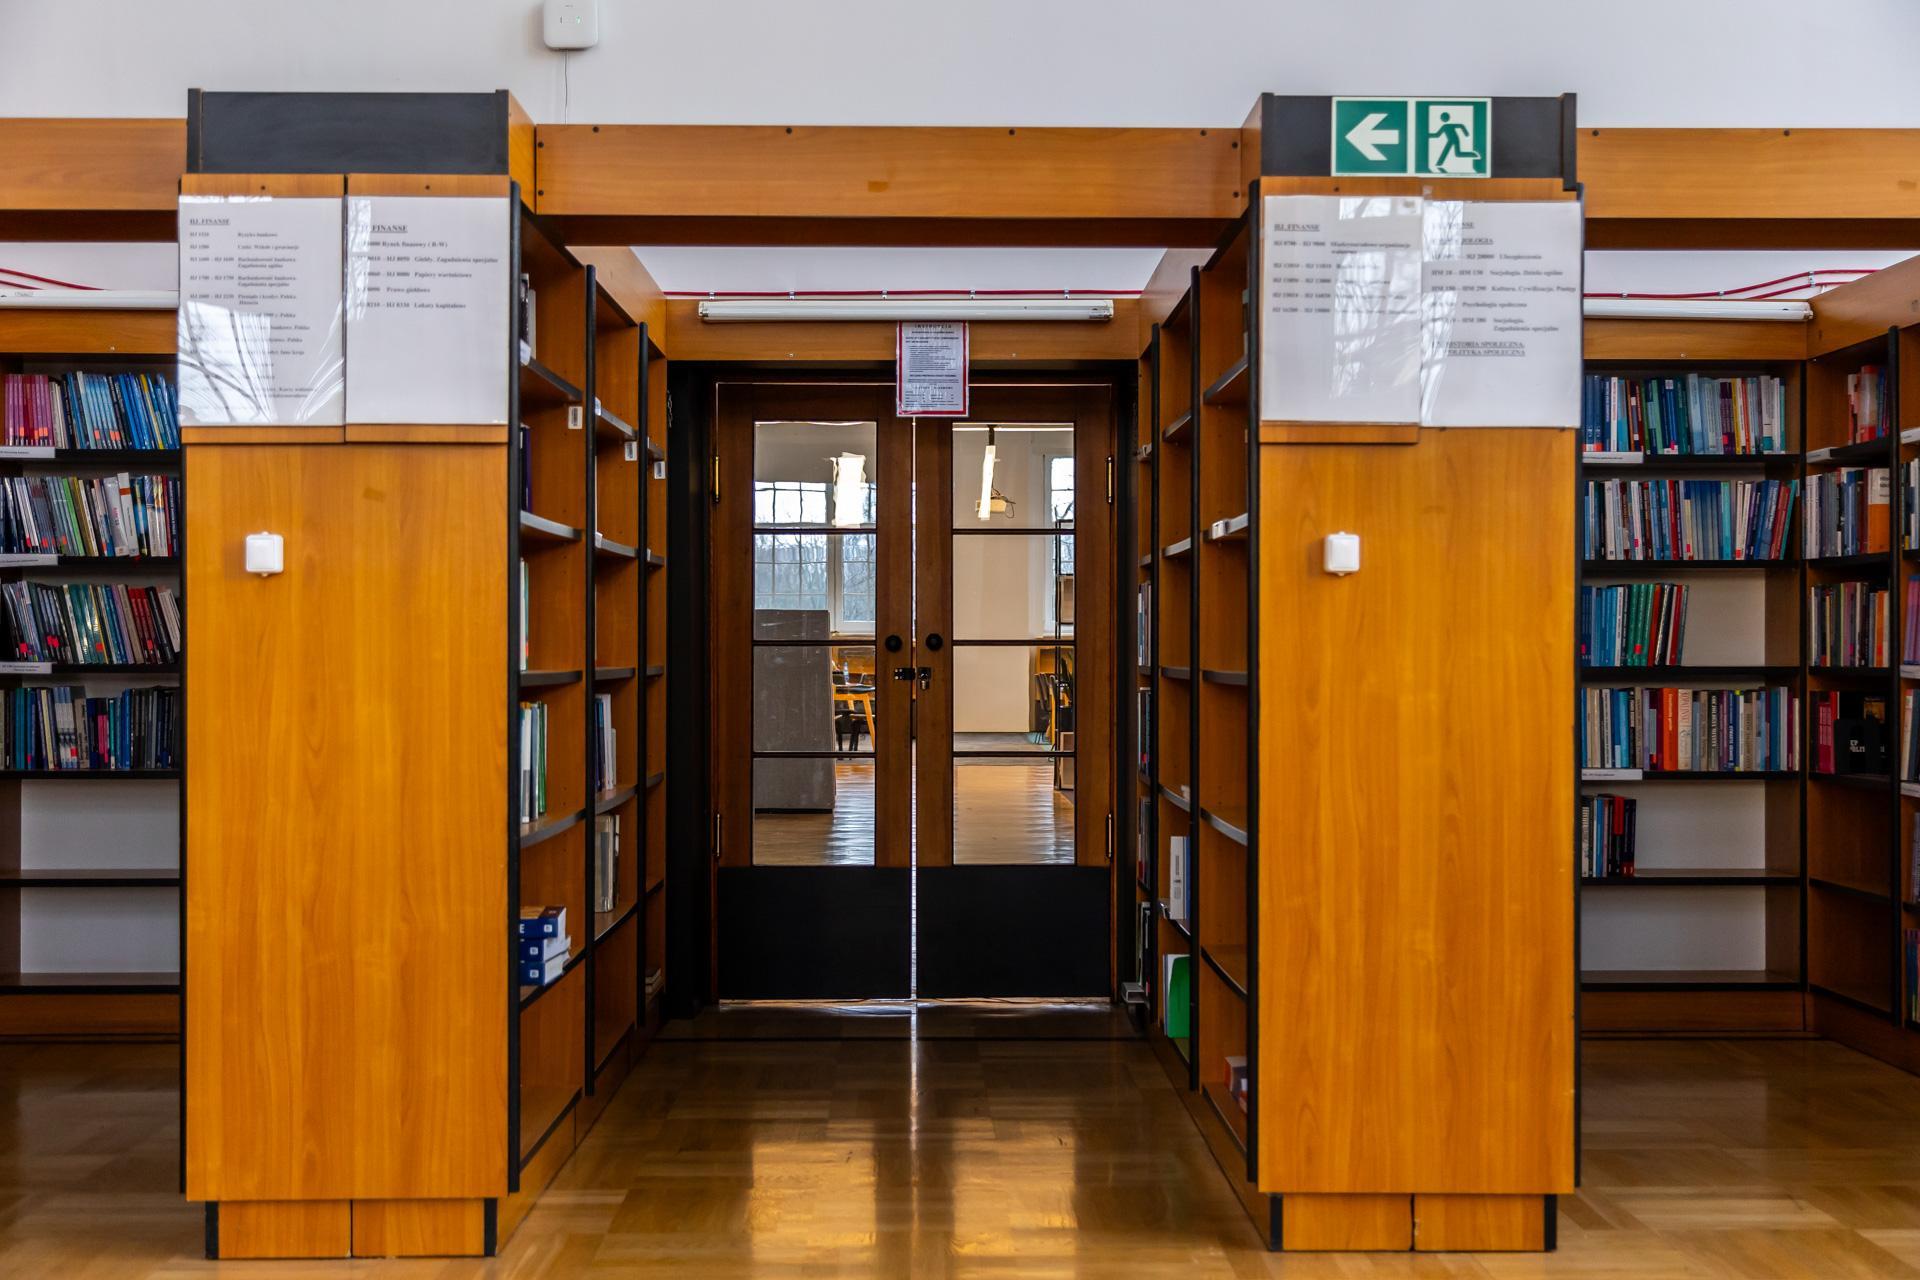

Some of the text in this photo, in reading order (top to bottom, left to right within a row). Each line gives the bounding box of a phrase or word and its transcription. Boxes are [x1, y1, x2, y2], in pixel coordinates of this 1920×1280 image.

[201, 218, 230, 226] FINANSE
[372, 224, 408, 234] FINANSE
[1287, 224, 1320, 232] FINANSE
[402, 241, 426, 249] finansowy
[436, 256, 471, 264] Zagadnienia
[435, 302, 466, 310] kapitałowe
